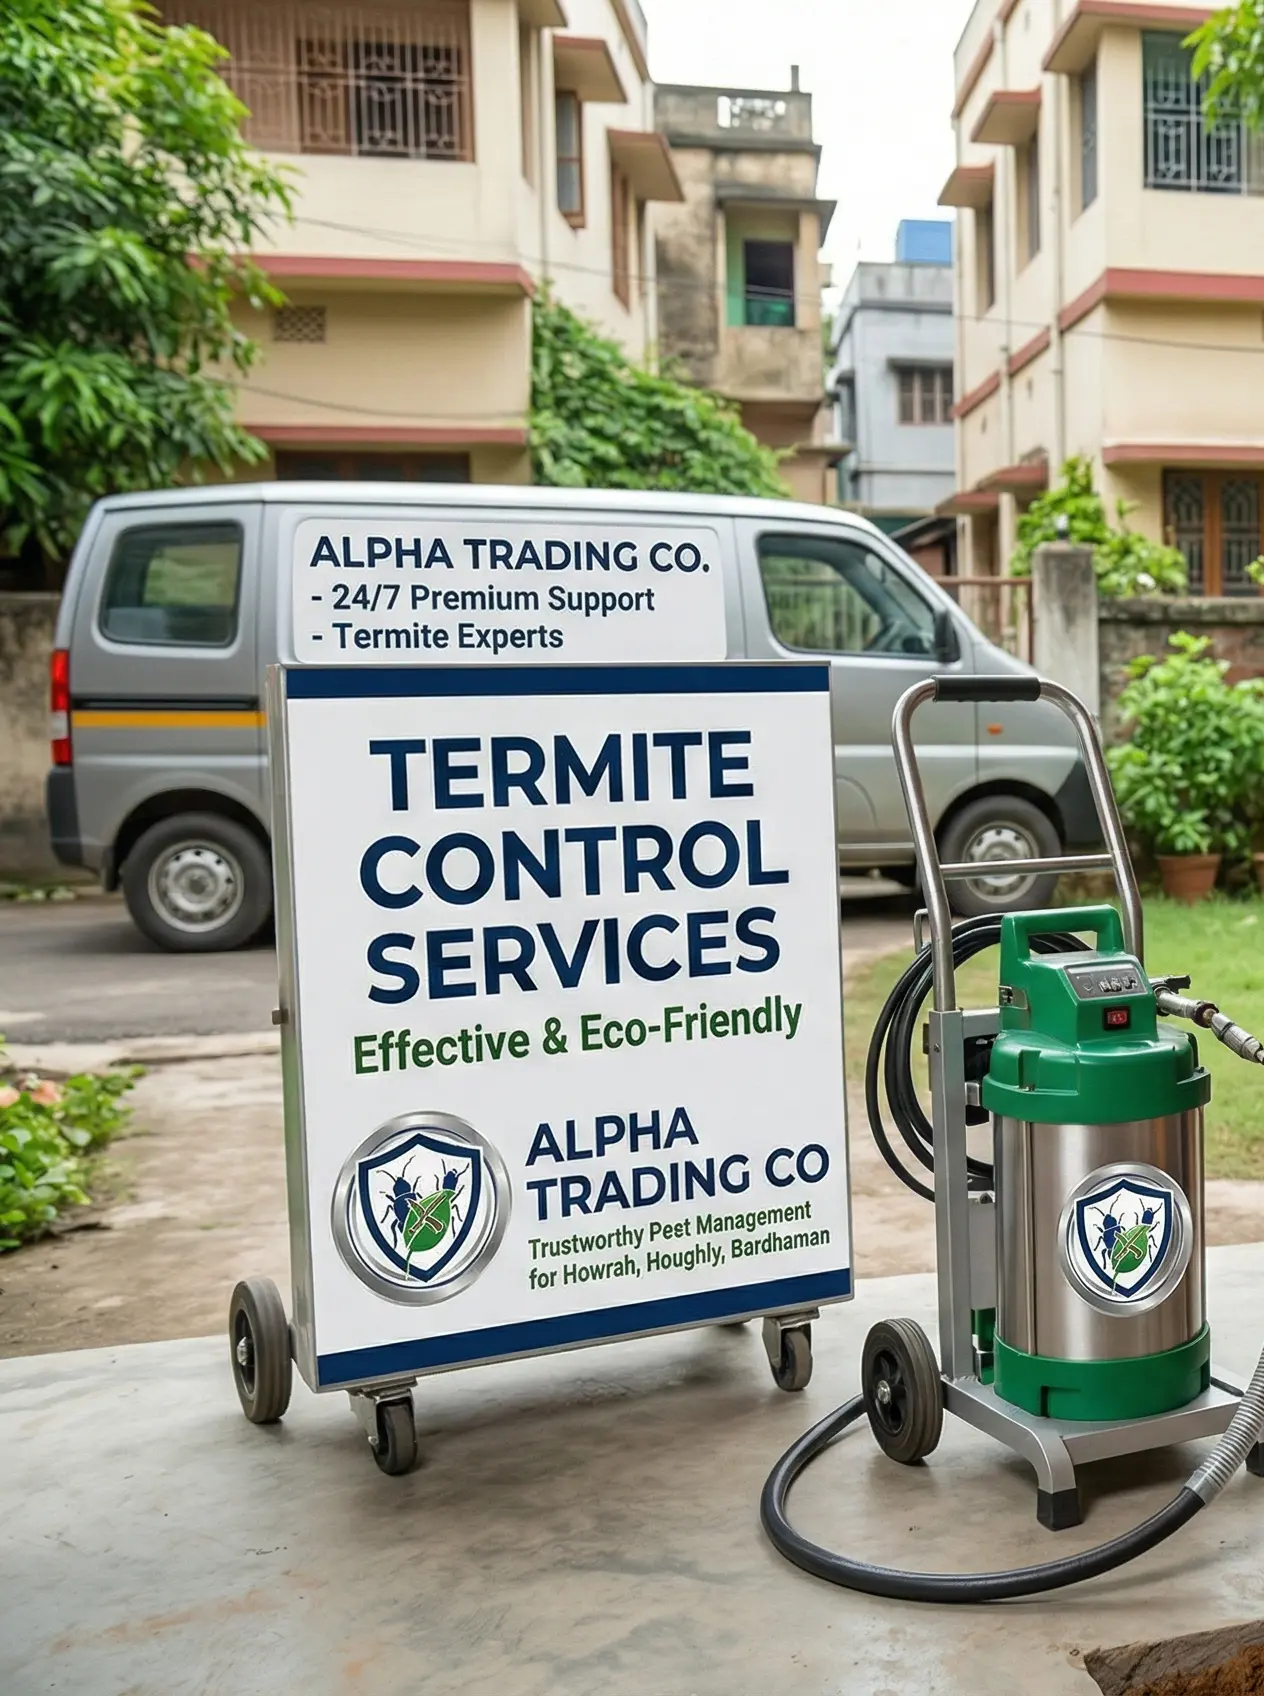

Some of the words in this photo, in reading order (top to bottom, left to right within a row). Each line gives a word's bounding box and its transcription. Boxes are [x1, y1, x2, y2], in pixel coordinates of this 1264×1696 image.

[309, 535, 455, 569] ALPHA
[462, 538, 638, 572] TRADING
[649, 542, 710, 573] CO.
[331, 583, 401, 613] 24/7
[410, 584, 539, 611] Premium
[548, 585, 655, 618] Support
[331, 621, 449, 650] Termite
[458, 622, 564, 656] Experts
[369, 730, 754, 812] TERMITE
[359, 819, 790, 910] CONTROL
[366, 906, 781, 1005] SERVICES
[353, 1023, 530, 1075] Effective
[542, 1016, 569, 1055] &
[580, 994, 803, 1051] Eco-Friendly
[524, 1106, 700, 1167] ALPHA
[525, 1153, 750, 1222] TRADING
[764, 1143, 830, 1188] CO
[527, 1224, 645, 1261] Trustworthy
[649, 1218, 692, 1242] Pest
[695, 1200, 812, 1233] Management
[528, 1267, 558, 1290] for
[562, 1253, 642, 1286] Howrah,
[646, 1241, 726, 1271] Houghly,
[730, 1228, 831, 1259] Bardhaman
